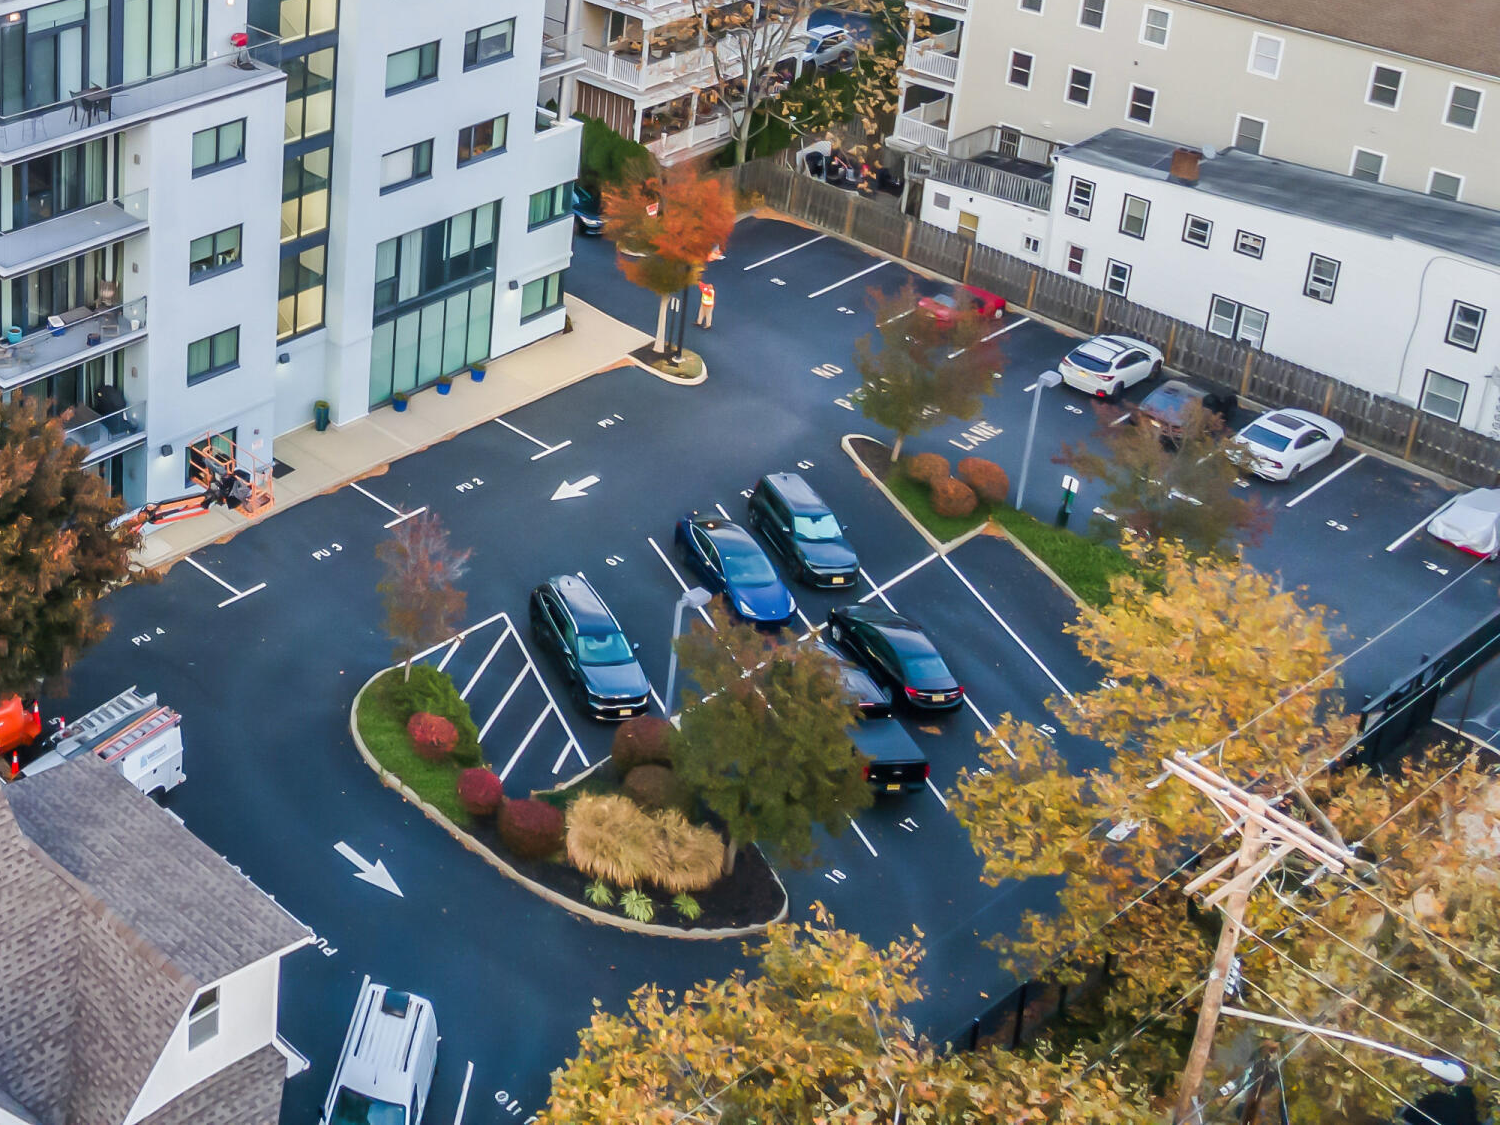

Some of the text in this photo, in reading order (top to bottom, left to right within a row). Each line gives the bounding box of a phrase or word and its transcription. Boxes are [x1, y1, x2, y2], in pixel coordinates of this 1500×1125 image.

[810, 363, 844, 379] NO
[613, 413, 624, 421] 1
[948, 420, 1004, 451] LANE
[472, 477, 484, 486] 2
[311, 543, 343, 561] PU 3
[131, 627, 166, 646] PU 4
